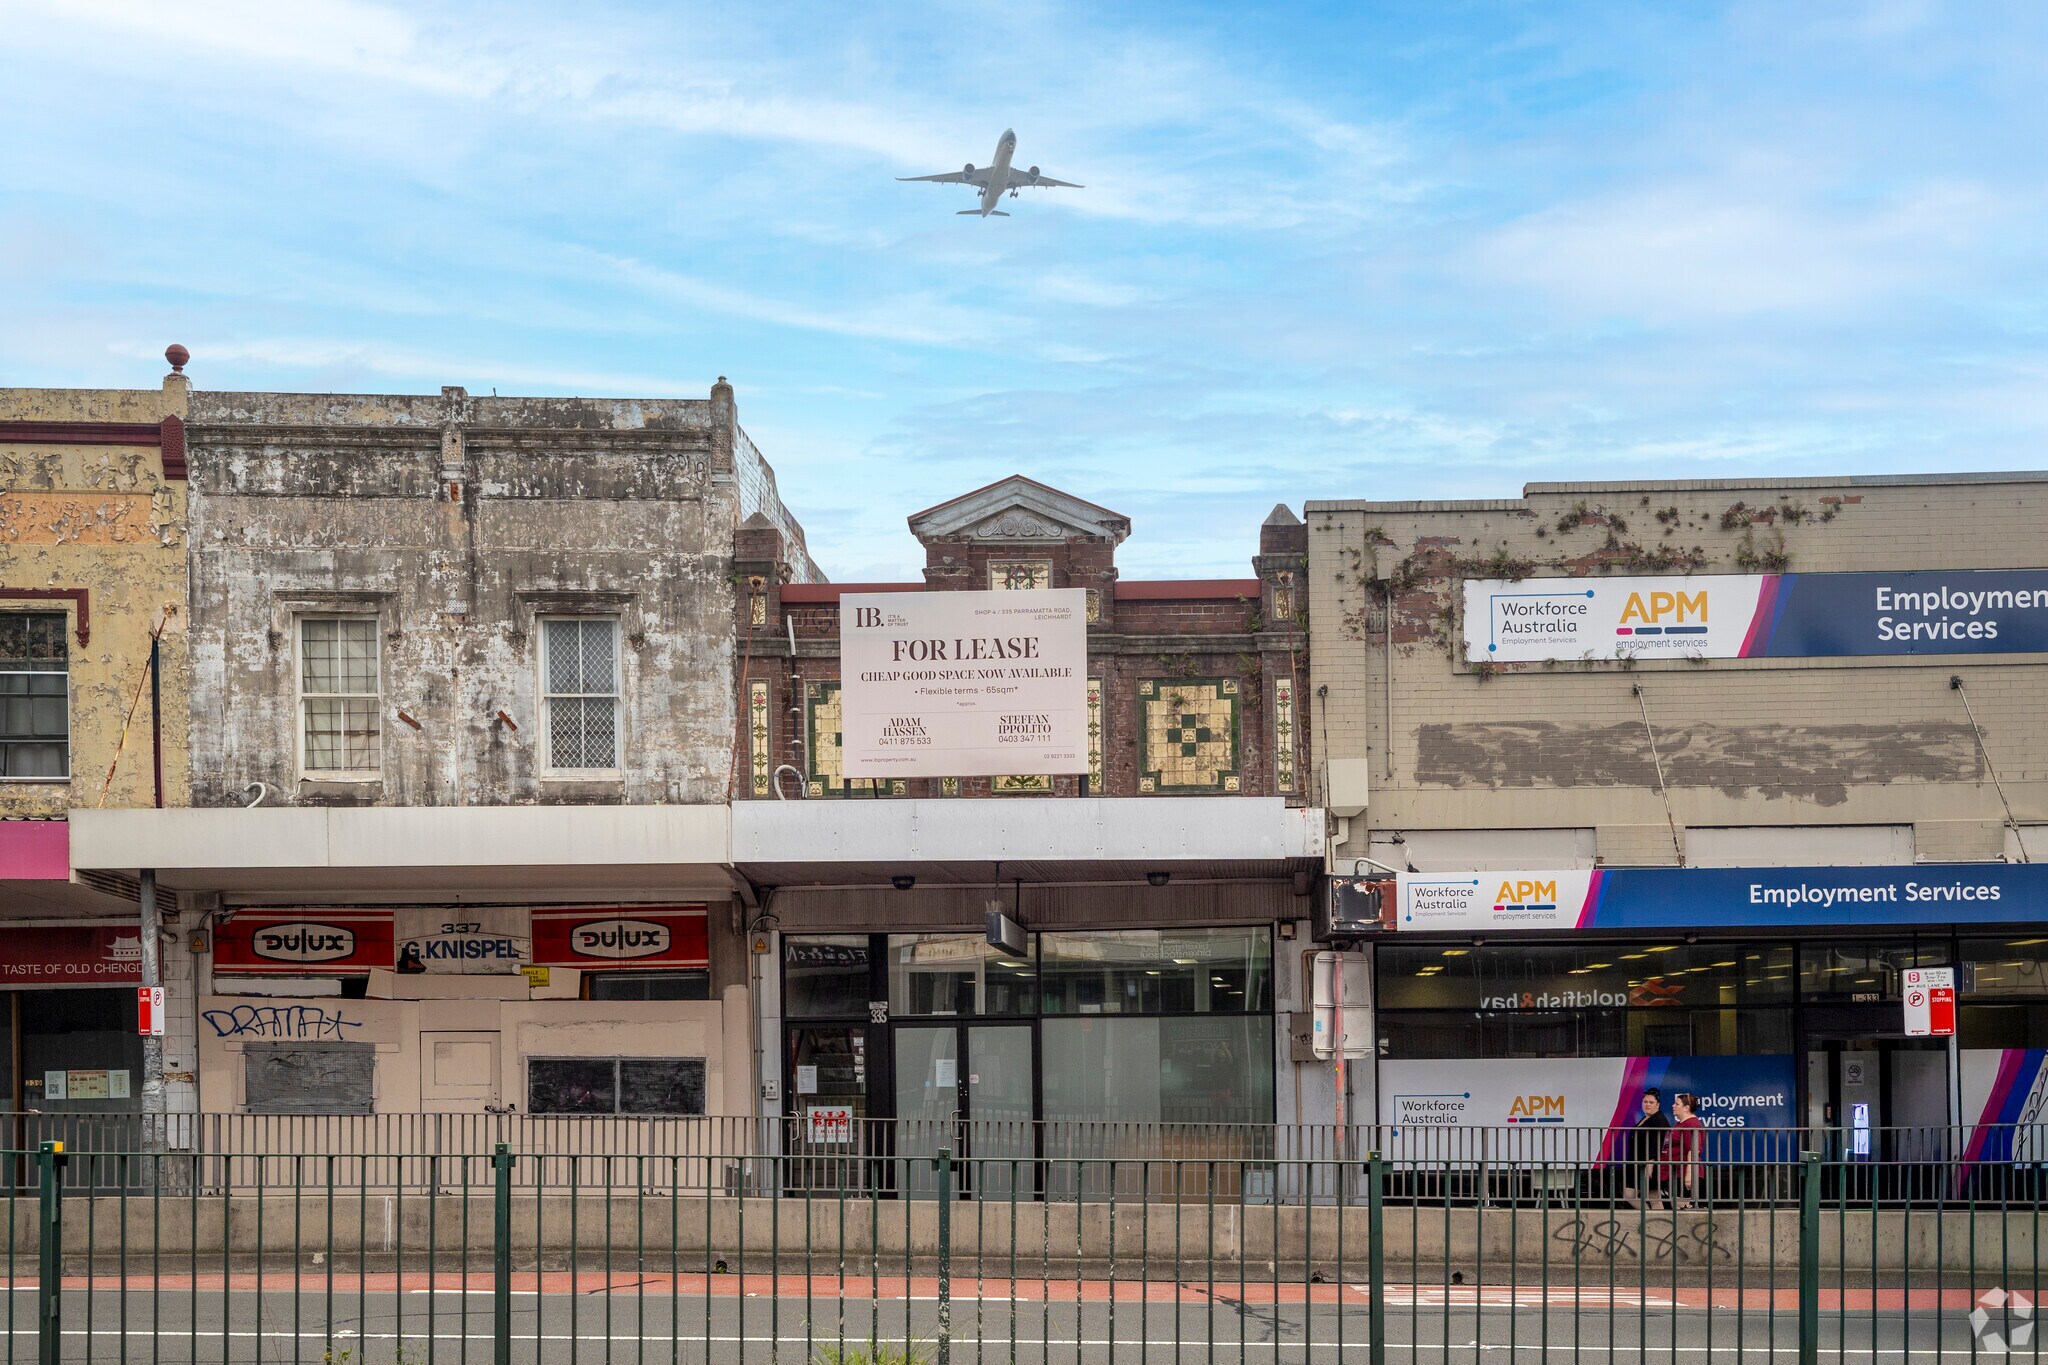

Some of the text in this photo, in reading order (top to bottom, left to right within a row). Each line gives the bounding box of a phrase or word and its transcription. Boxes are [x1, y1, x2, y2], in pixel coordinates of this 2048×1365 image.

[1876, 586, 2048, 616] Employmen
[1501, 602, 1587, 616] Workforce
[1619, 591, 1708, 624] APM
[1501, 619, 1578, 634] Australia
[1877, 616, 1998, 641] Services
[1501, 636, 1577, 645] Employment Services
[1616, 638, 1708, 649] employment services
[892, 637, 1039, 661] FOR LEASE
[861, 667, 1072, 681] CHEAP GOOD SPACE NOW AVAILABLE
[920, 687, 952, 695] Flexible
[888, 717, 921, 727] ADAM
[1000, 714, 1049, 724] STEFFAN
[883, 727, 927, 736] HASSEN
[998, 724, 1051, 734] IPPOLITO
[900, 737, 915, 745] 875
[998, 734, 1051, 743] 0403 347 111
[1414, 886, 1474, 898] Workforce
[1495, 880, 1557, 903] APM
[1750, 881, 2001, 907] Employment Services
[1414, 899, 1467, 909] Australia
[1493, 912, 1557, 921] employment services
[441, 922, 481, 934] 337
[404, 939, 519, 959] G.KNISPEL
[2, 964, 41, 975] TASTE
[45, 964, 61, 974] OF
[65, 963, 90, 974] OLD
[871, 1010, 887, 1024] 335
[1401, 1100, 1465, 1111] Workforce
[1509, 1095, 1565, 1116] APM
[1401, 1113, 1458, 1124] Australia
